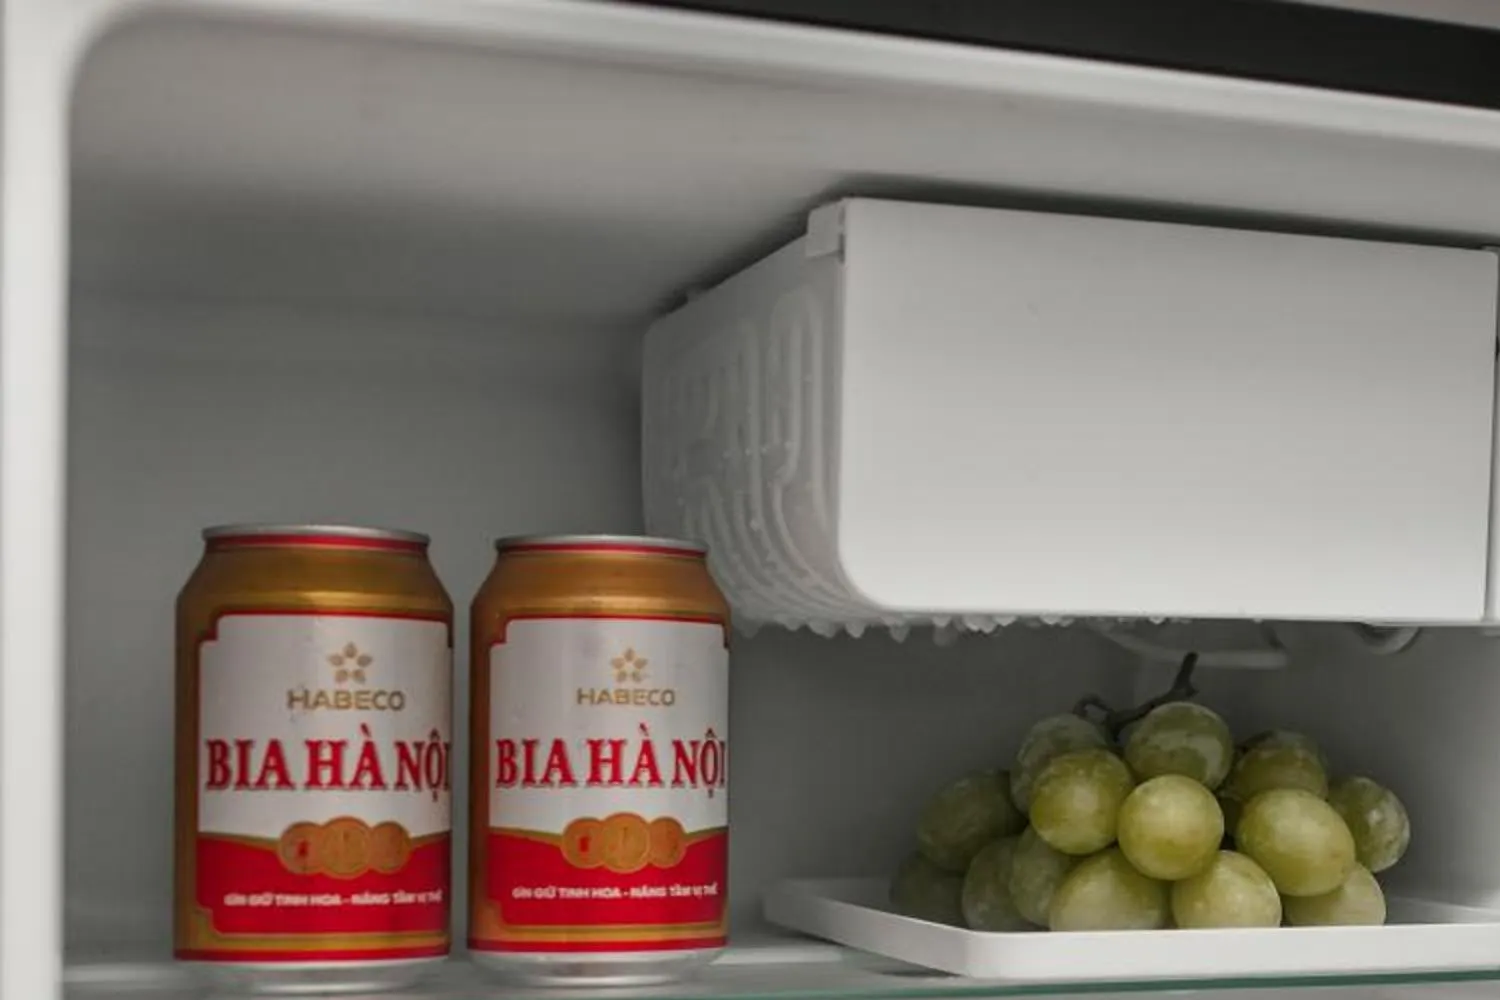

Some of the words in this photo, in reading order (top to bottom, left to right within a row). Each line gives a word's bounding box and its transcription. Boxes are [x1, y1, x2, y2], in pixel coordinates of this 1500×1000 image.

[287, 689, 406, 711] HABECO
[576, 687, 675, 707] HABECO
[205, 738, 295, 791] BIA
[304, 722, 388, 791] HÀ
[395, 727, 450, 802] NỘI
[495, 738, 575, 789] BIA
[586, 722, 663, 789] HÀ
[670, 727, 726, 798] NỘI
